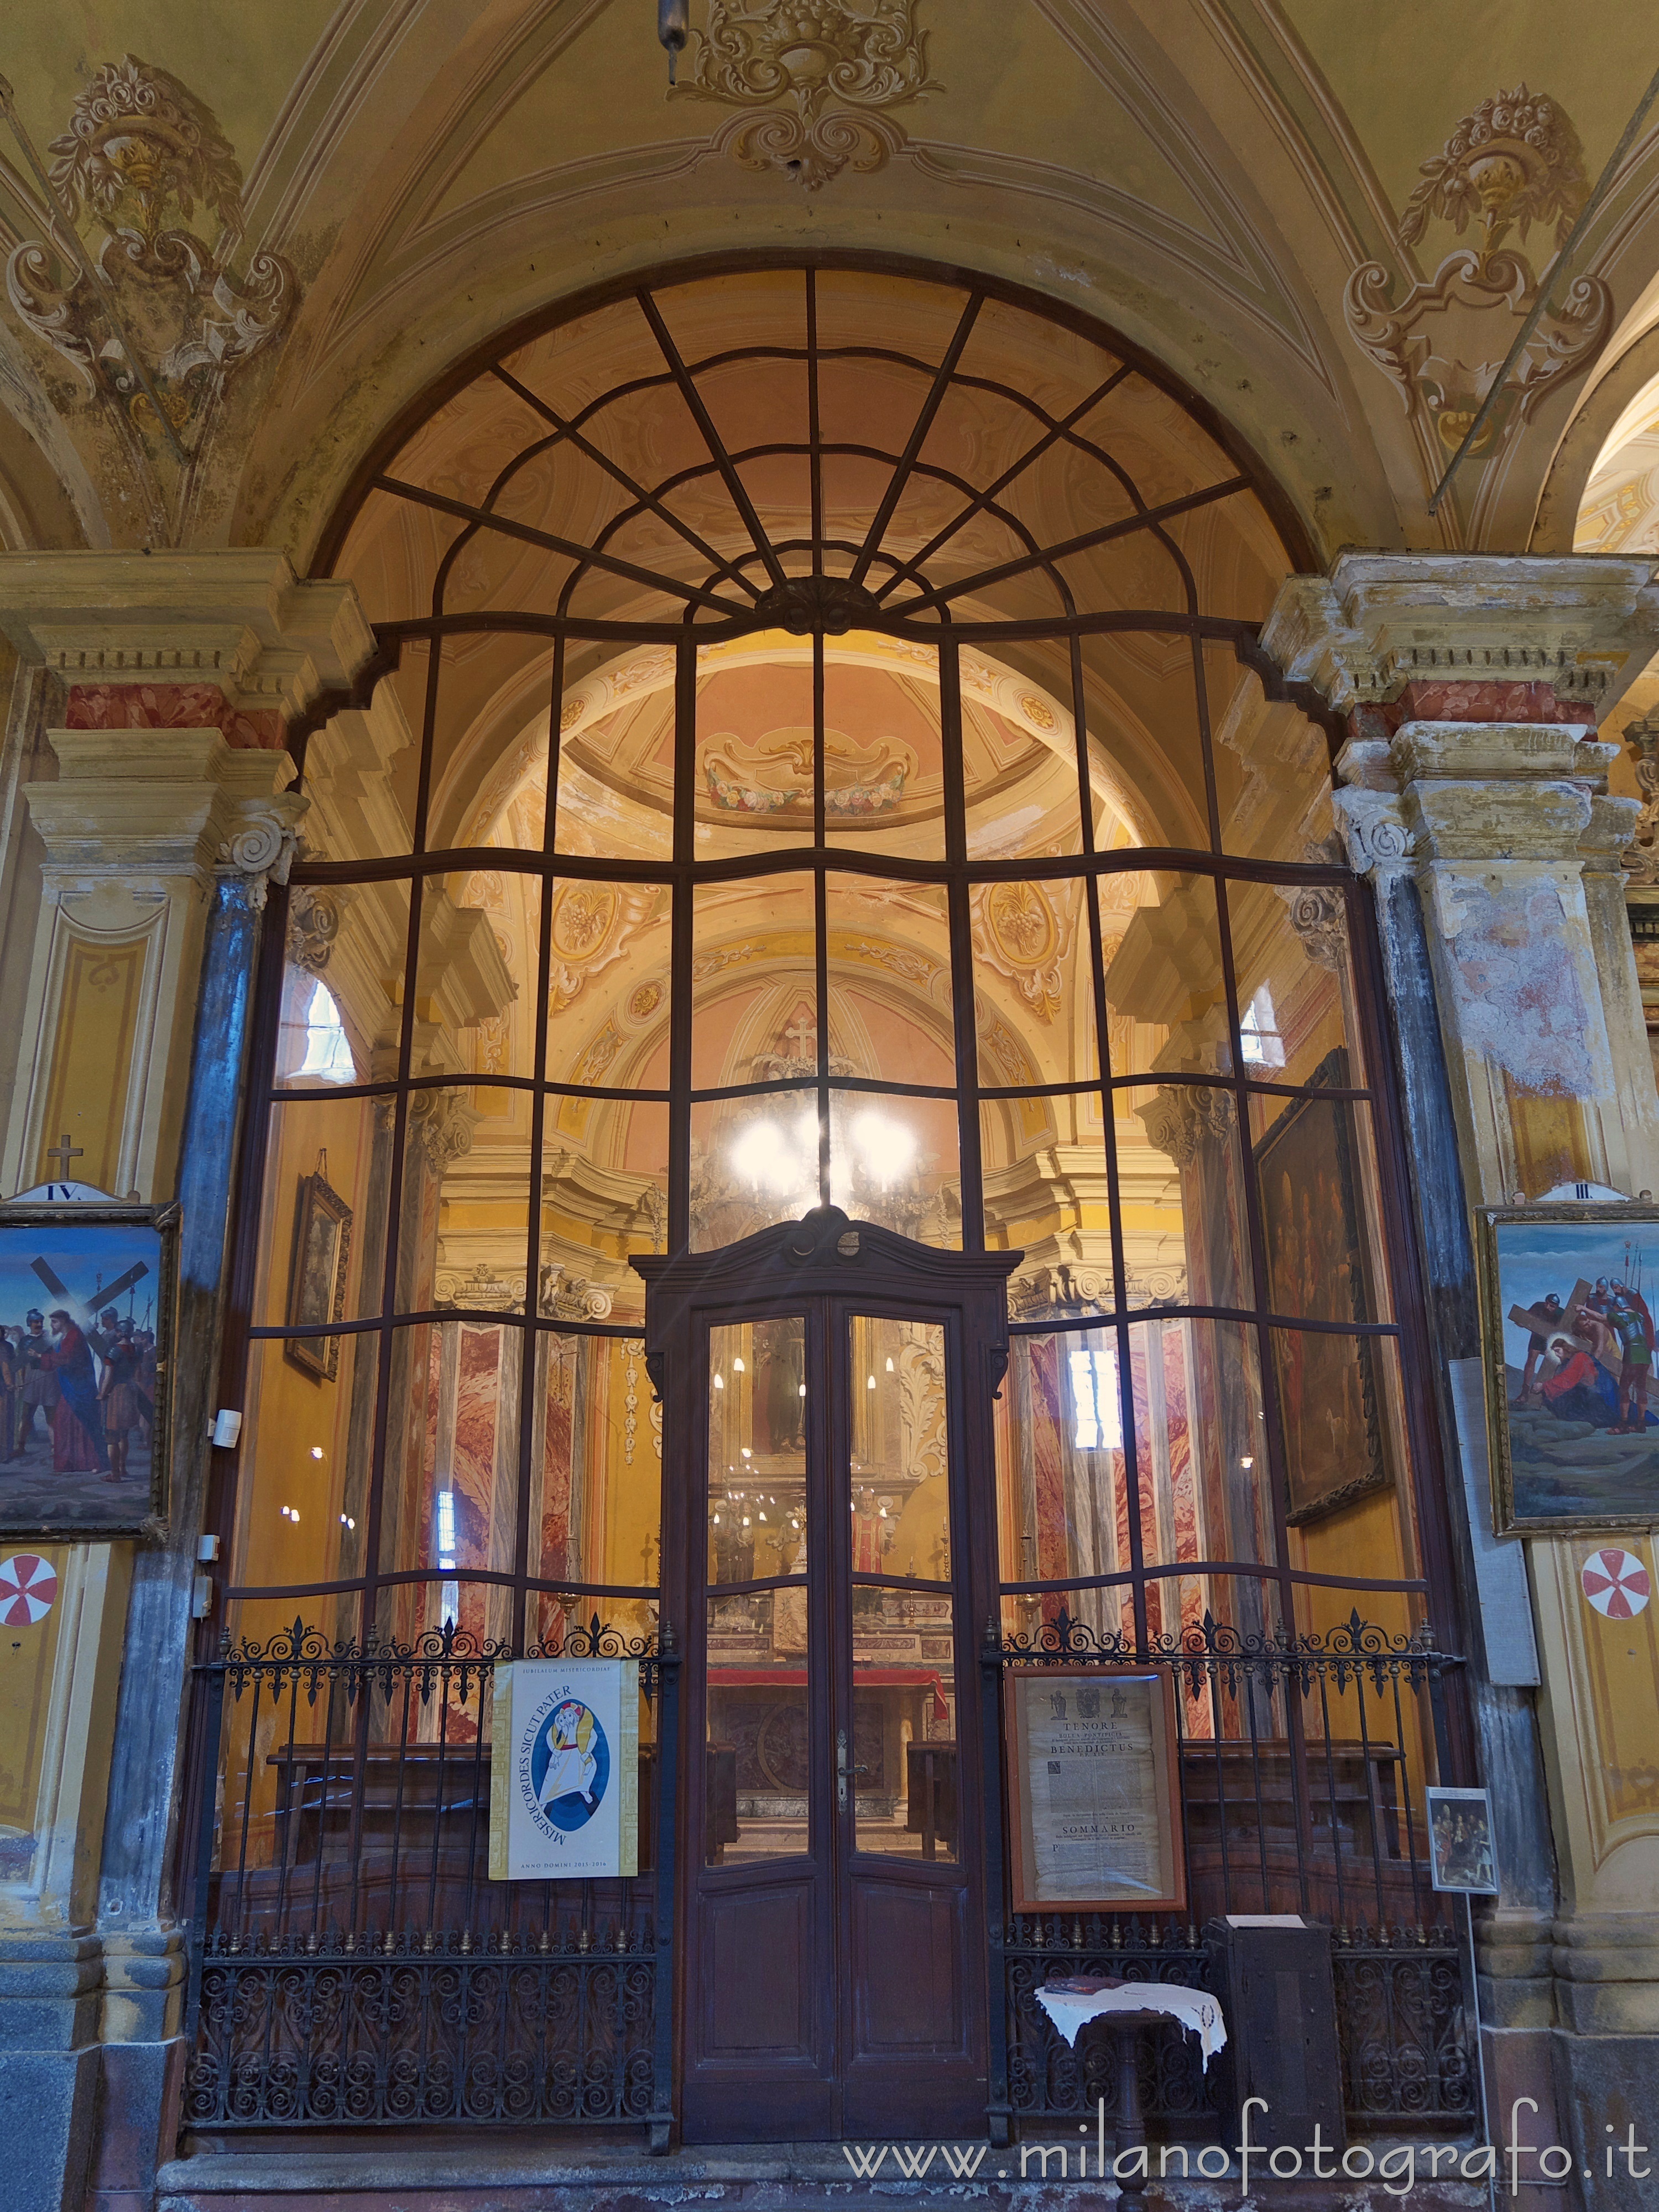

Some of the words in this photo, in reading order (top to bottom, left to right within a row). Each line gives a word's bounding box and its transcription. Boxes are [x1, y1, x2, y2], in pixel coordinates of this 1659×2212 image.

[536, 1685, 572, 1716] PATER
[520, 1714, 541, 1754] SICUT
[1063, 1722, 1118, 1731] TENORE
[1051, 1743, 1133, 1754] BENEDICTUS
[519, 1757, 567, 1846] MISERICORDES
[1062, 1824, 1135, 1834] SOMMARIO
